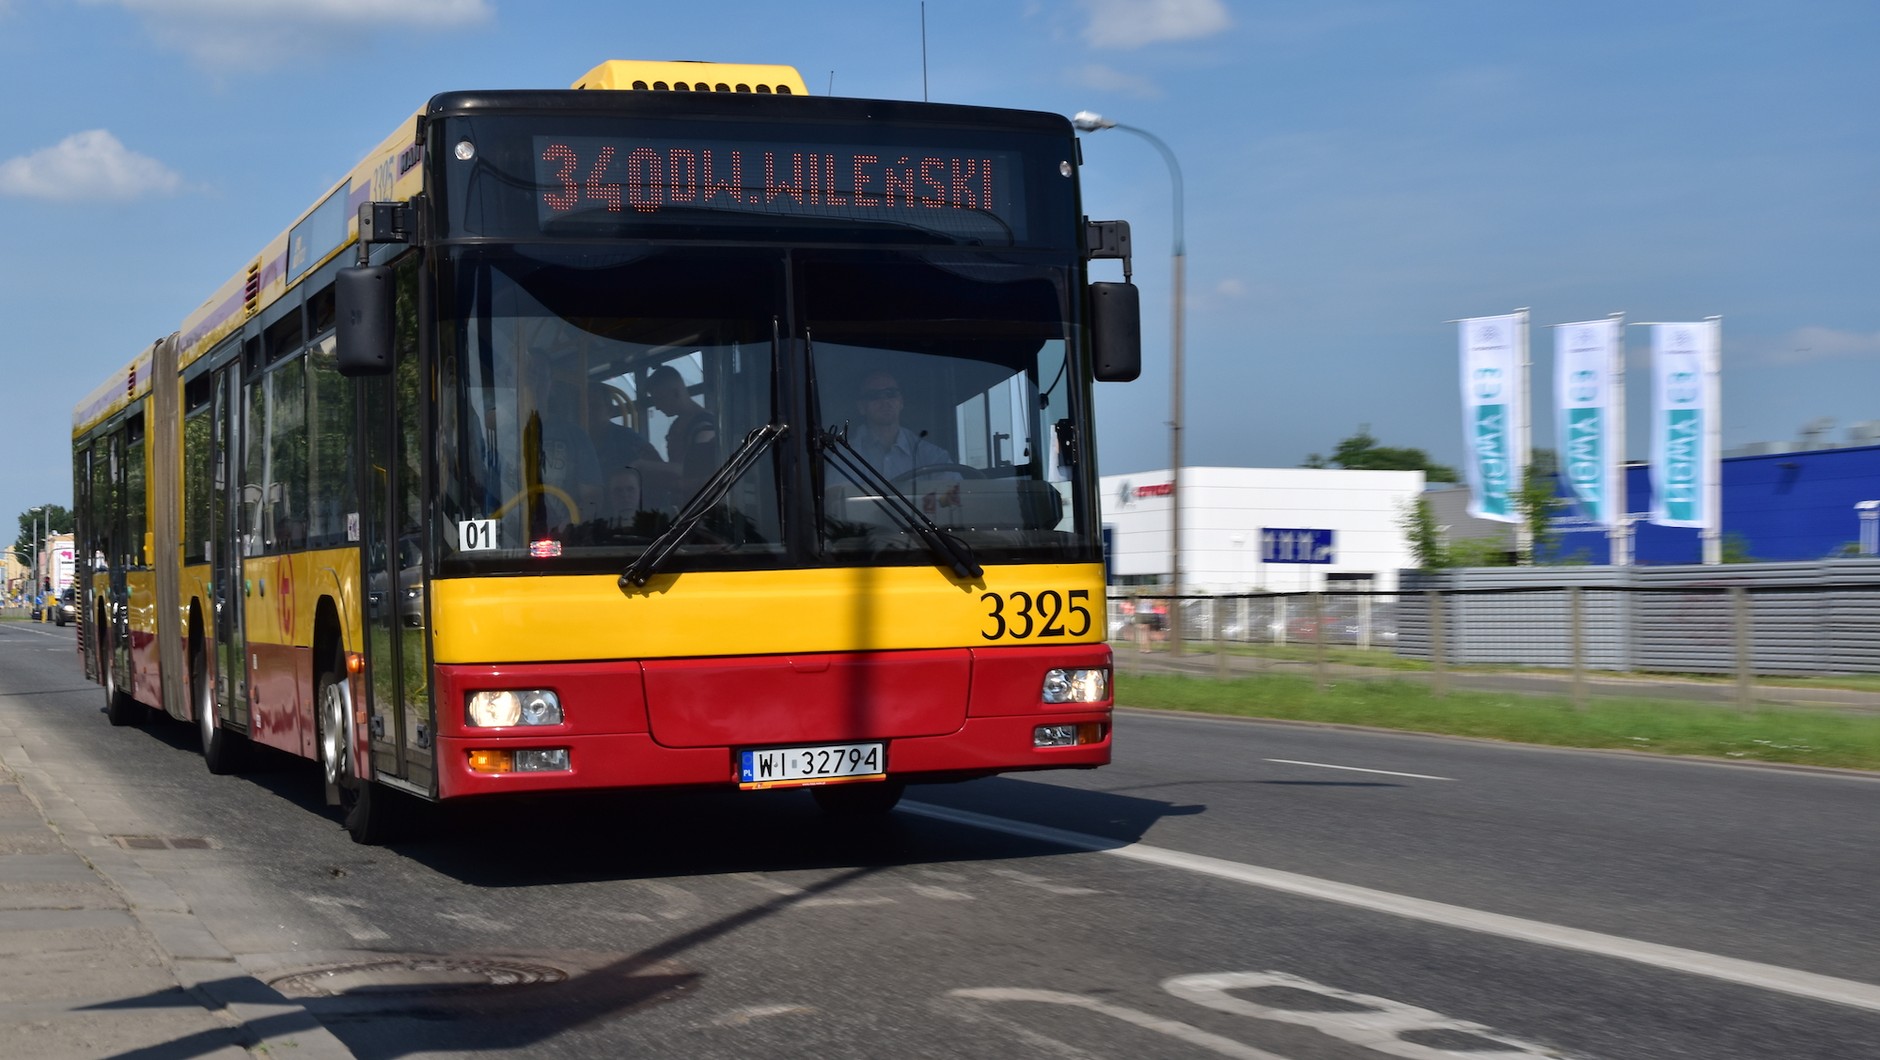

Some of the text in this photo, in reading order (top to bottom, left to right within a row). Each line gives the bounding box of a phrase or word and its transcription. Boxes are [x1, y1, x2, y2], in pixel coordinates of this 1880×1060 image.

[541, 144, 663, 213] 340
[466, 521, 491, 549] 01
[980, 589, 1091, 640] 3325
[743, 769, 752, 777] PL
[758, 747, 877, 778] WI 32794
